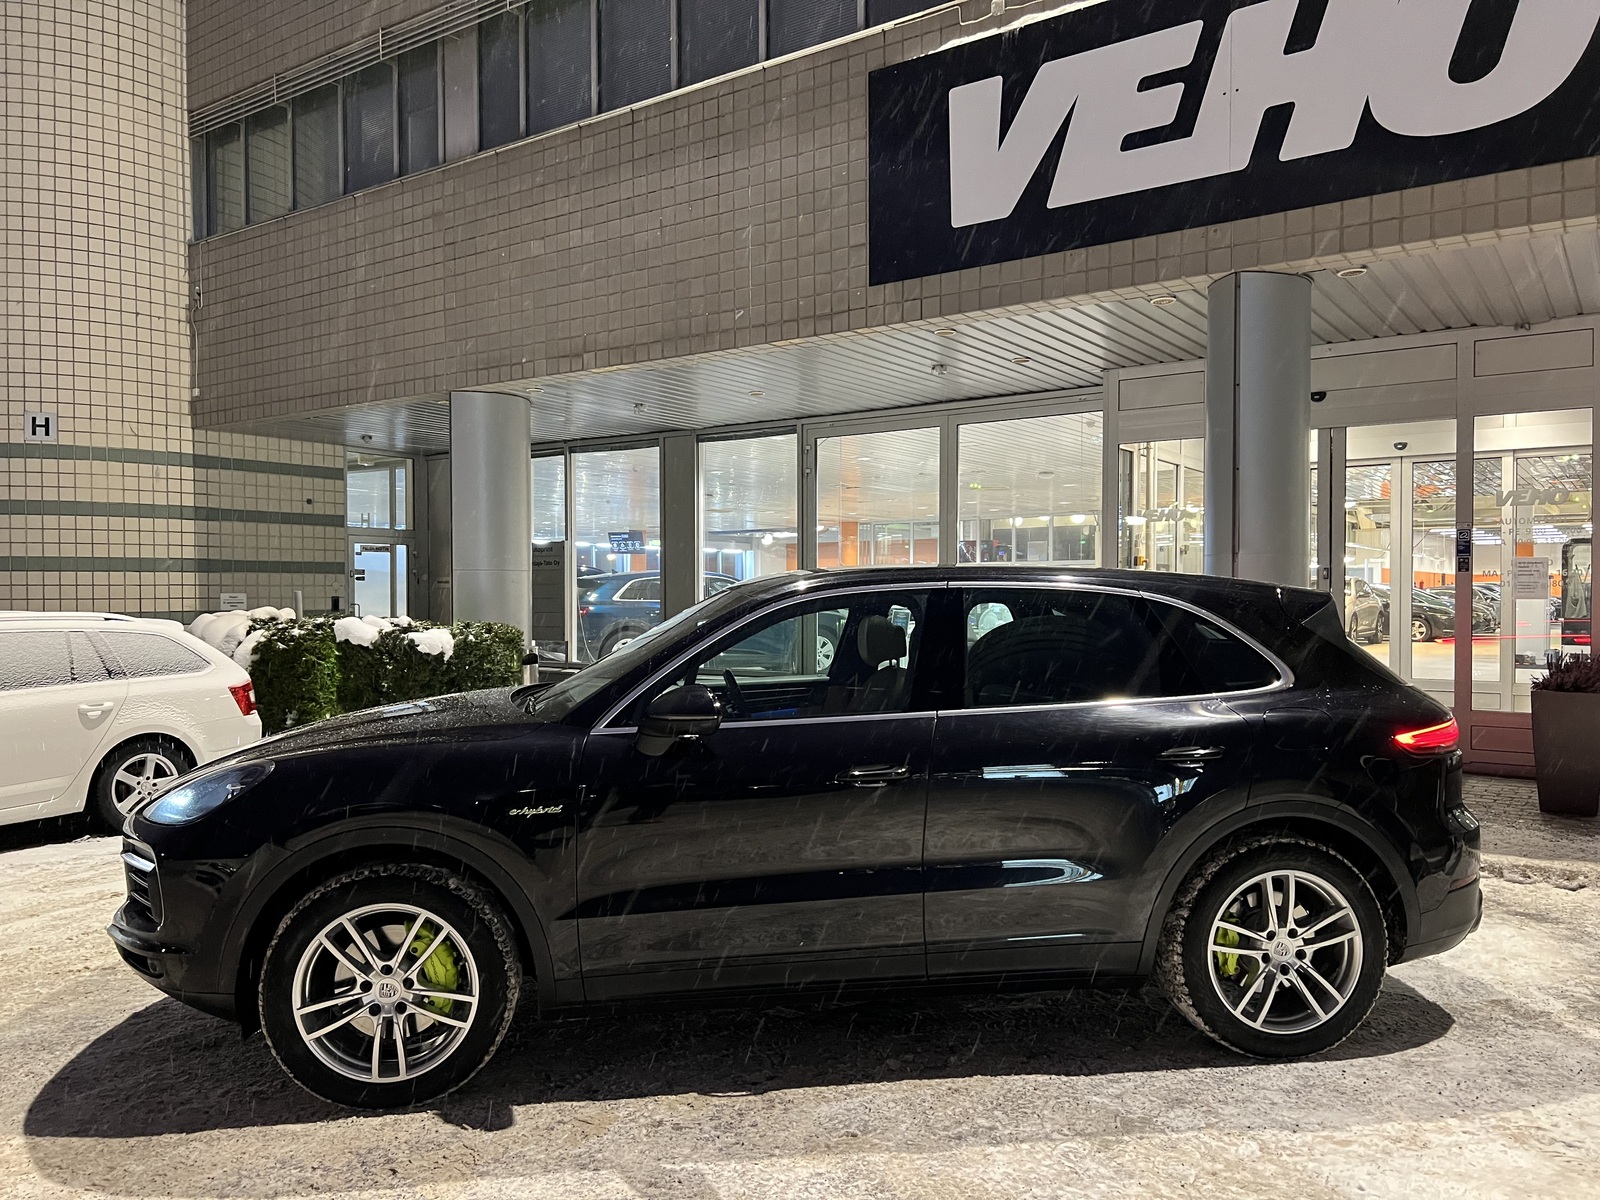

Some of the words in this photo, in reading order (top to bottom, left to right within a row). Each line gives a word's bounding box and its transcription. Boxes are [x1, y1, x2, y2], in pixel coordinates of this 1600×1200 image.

[949, 0, 1600, 228] VEHO
[31, 416, 50, 436] H
[1496, 487, 1570, 507] VEHO
